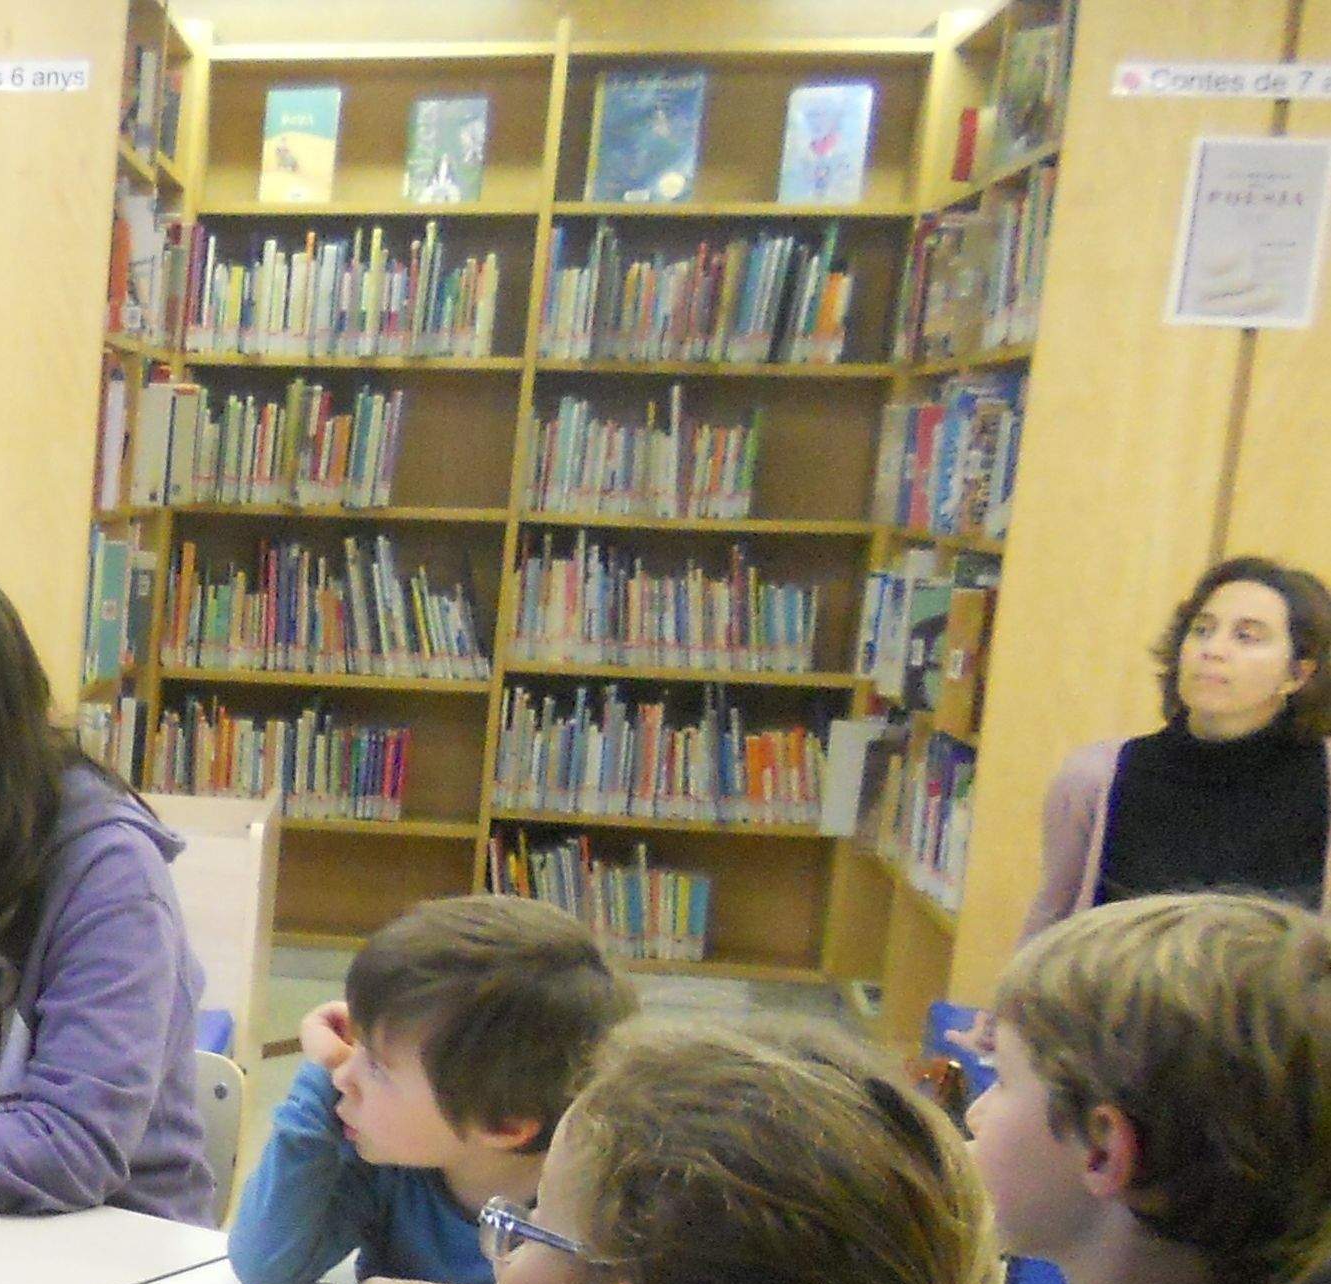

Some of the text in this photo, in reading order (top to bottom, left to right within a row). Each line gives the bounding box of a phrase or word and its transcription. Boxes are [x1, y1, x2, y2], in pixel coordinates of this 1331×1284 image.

[10, 67, 25, 87] 6
[32, 69, 86, 92] anys
[1151, 68, 1246, 92] Contes
[1255, 73, 1288, 91] de
[1299, 70, 1314, 90] 7
